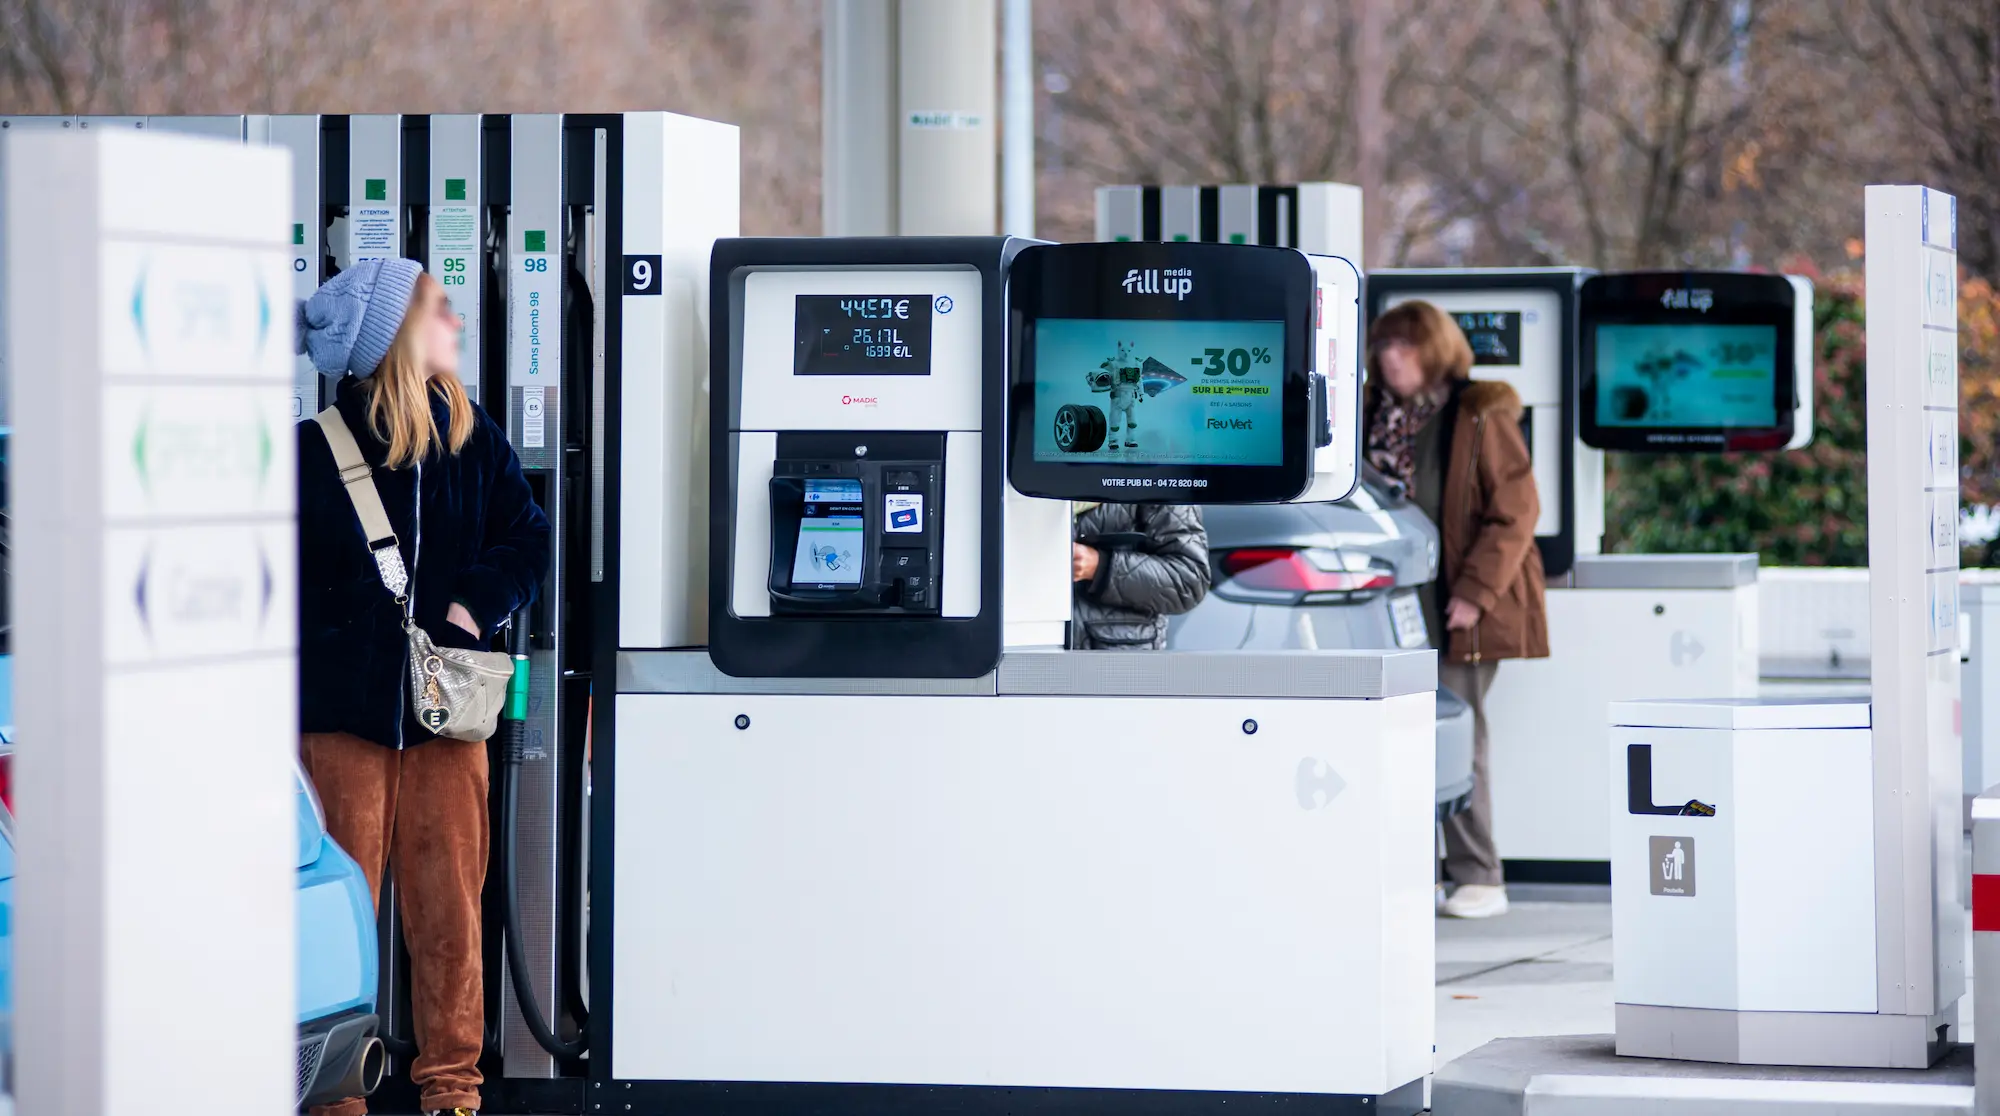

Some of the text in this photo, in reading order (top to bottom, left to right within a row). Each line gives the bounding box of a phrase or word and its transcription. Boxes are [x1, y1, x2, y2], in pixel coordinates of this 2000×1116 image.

[443, 258, 466, 272] 95
[524, 258, 547, 272] 98
[1163, 267, 1193, 277] media
[443, 275, 465, 285] E10
[632, 259, 653, 291] 9
[1121, 268, 1193, 301] fill up
[529, 291, 540, 307] 98
[529, 308, 541, 346] plomb
[529, 347, 539, 375] Sans
[1191, 346, 1272, 377] -30%
[1192, 386, 1211, 394] SUR
[1244, 387, 1269, 395] PNEU
[1207, 418, 1253, 430] Feu Vert
[1101, 478, 1126, 487] VOTRE
[1126, 478, 1142, 487] PUB
[1142, 478, 1152, 487] ICI
[1157, 479, 1168, 487] 04
[1168, 479, 1177, 487] 72
[1178, 479, 1192, 488] 820
[1193, 479, 1208, 488] 800
[430, 712, 441, 726] E
